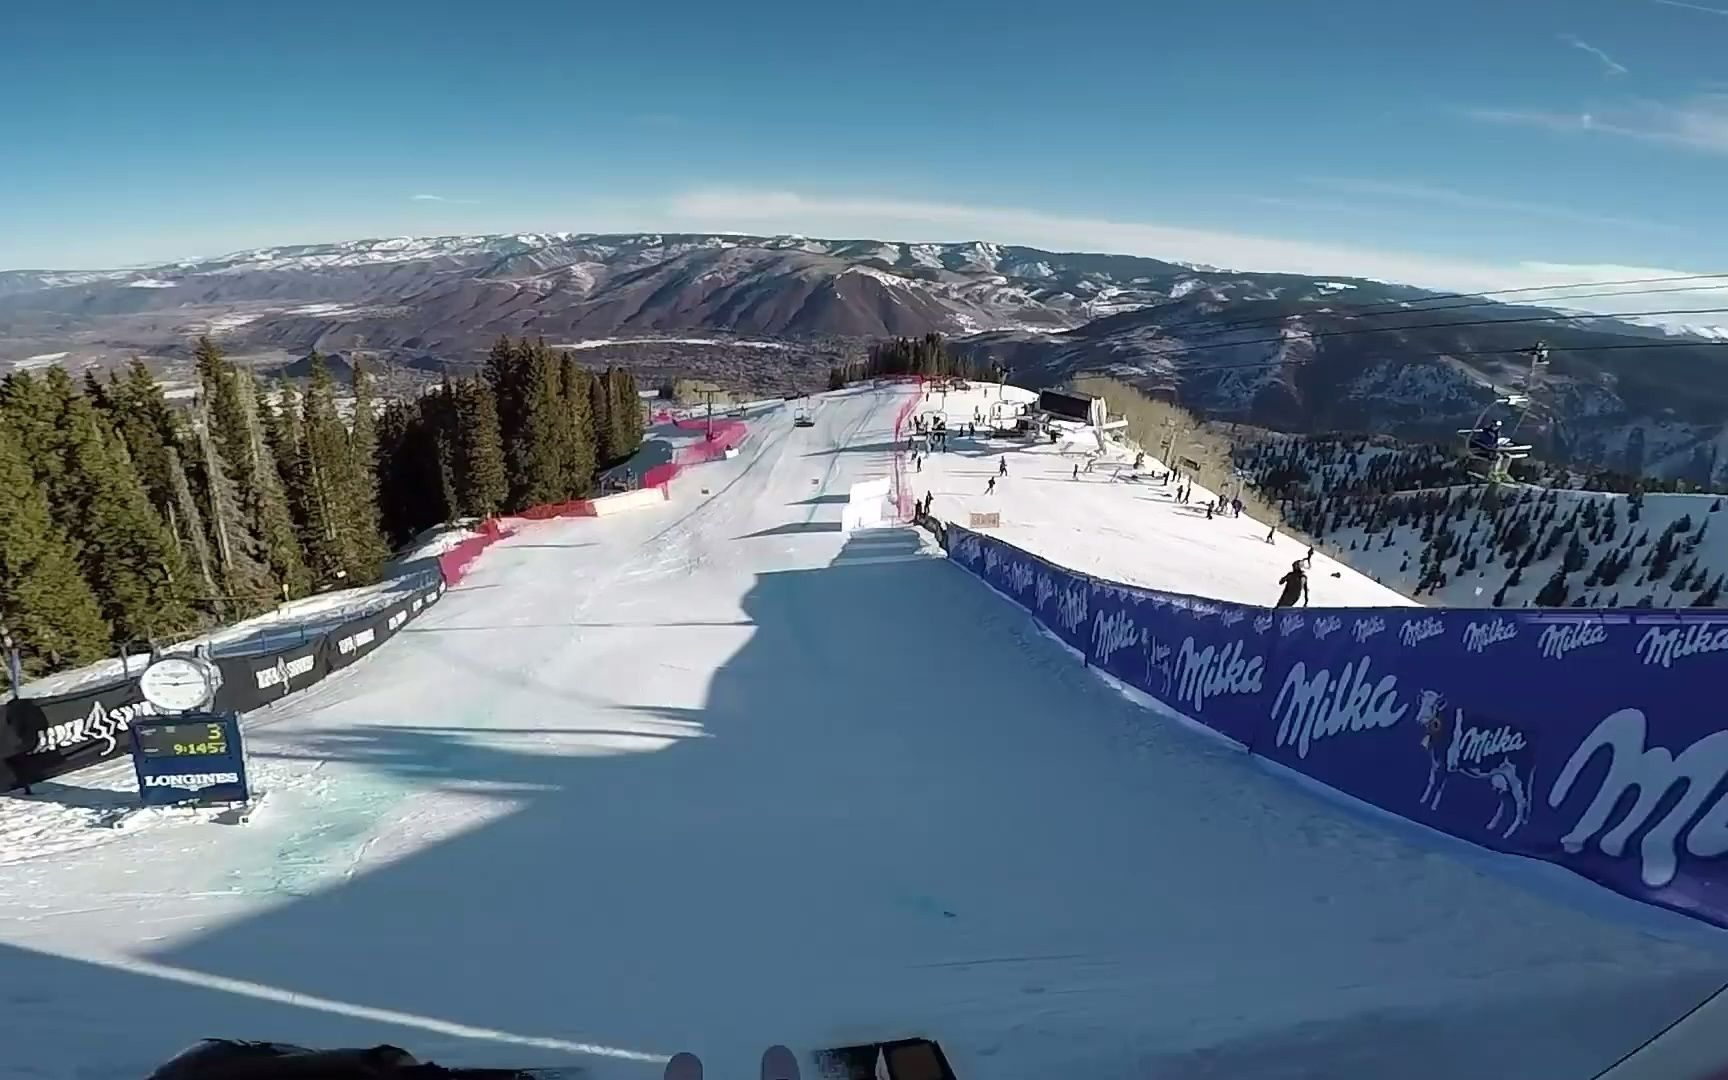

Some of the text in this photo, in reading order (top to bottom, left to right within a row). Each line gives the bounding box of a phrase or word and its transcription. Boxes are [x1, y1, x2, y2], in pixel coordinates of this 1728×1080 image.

[1092, 609, 1139, 664] Milka
[1399, 616, 1445, 647] Milka
[1462, 617, 1519, 653] Milka
[1538, 620, 1608, 660] Milka
[1636, 623, 1728, 668] Milka
[1174, 636, 1265, 711] Milka
[1270, 656, 1409, 758] Milka
[207, 724, 222, 740] 3
[1461, 725, 1527, 763] Milka
[144, 772, 238, 787] LONGINES
